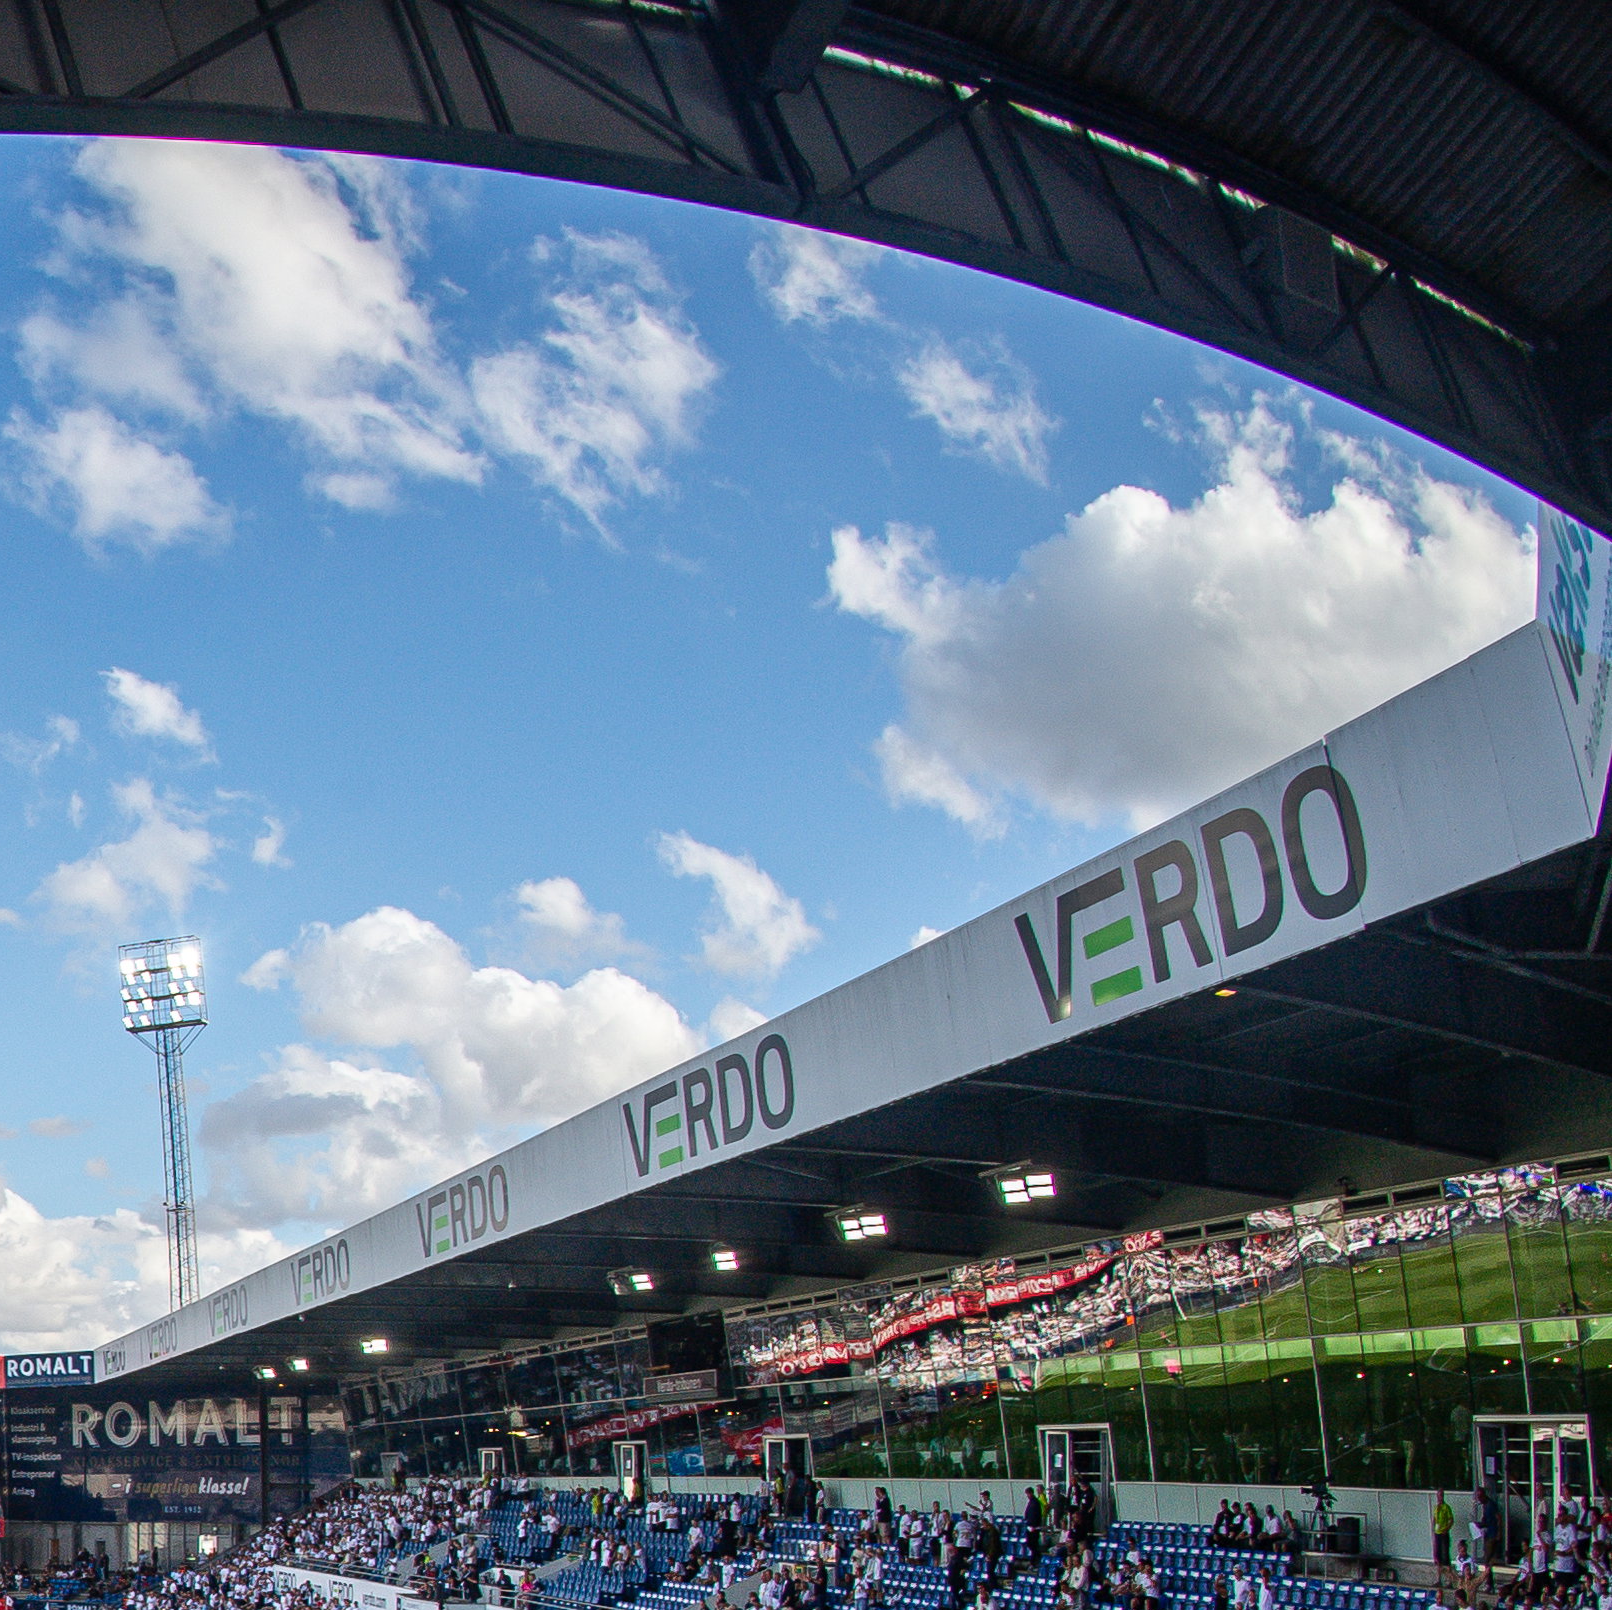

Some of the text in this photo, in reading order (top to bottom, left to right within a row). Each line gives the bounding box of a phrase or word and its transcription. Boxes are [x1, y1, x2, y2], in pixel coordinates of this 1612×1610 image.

[1013, 764, 1371, 1024] VERDO
[622, 1032, 796, 1178] VERDO
[416, 1164, 510, 1258] VERDO
[289, 1238, 351, 1307] VERDO
[207, 1284, 249, 1337] VERDO
[146, 1317, 178, 1360] VERDO
[6, 1354, 93, 1377] ROMALT
[71, 1397, 302, 1450] ROMALT
[194, 1454, 300, 1467] ENTREPRNØR
